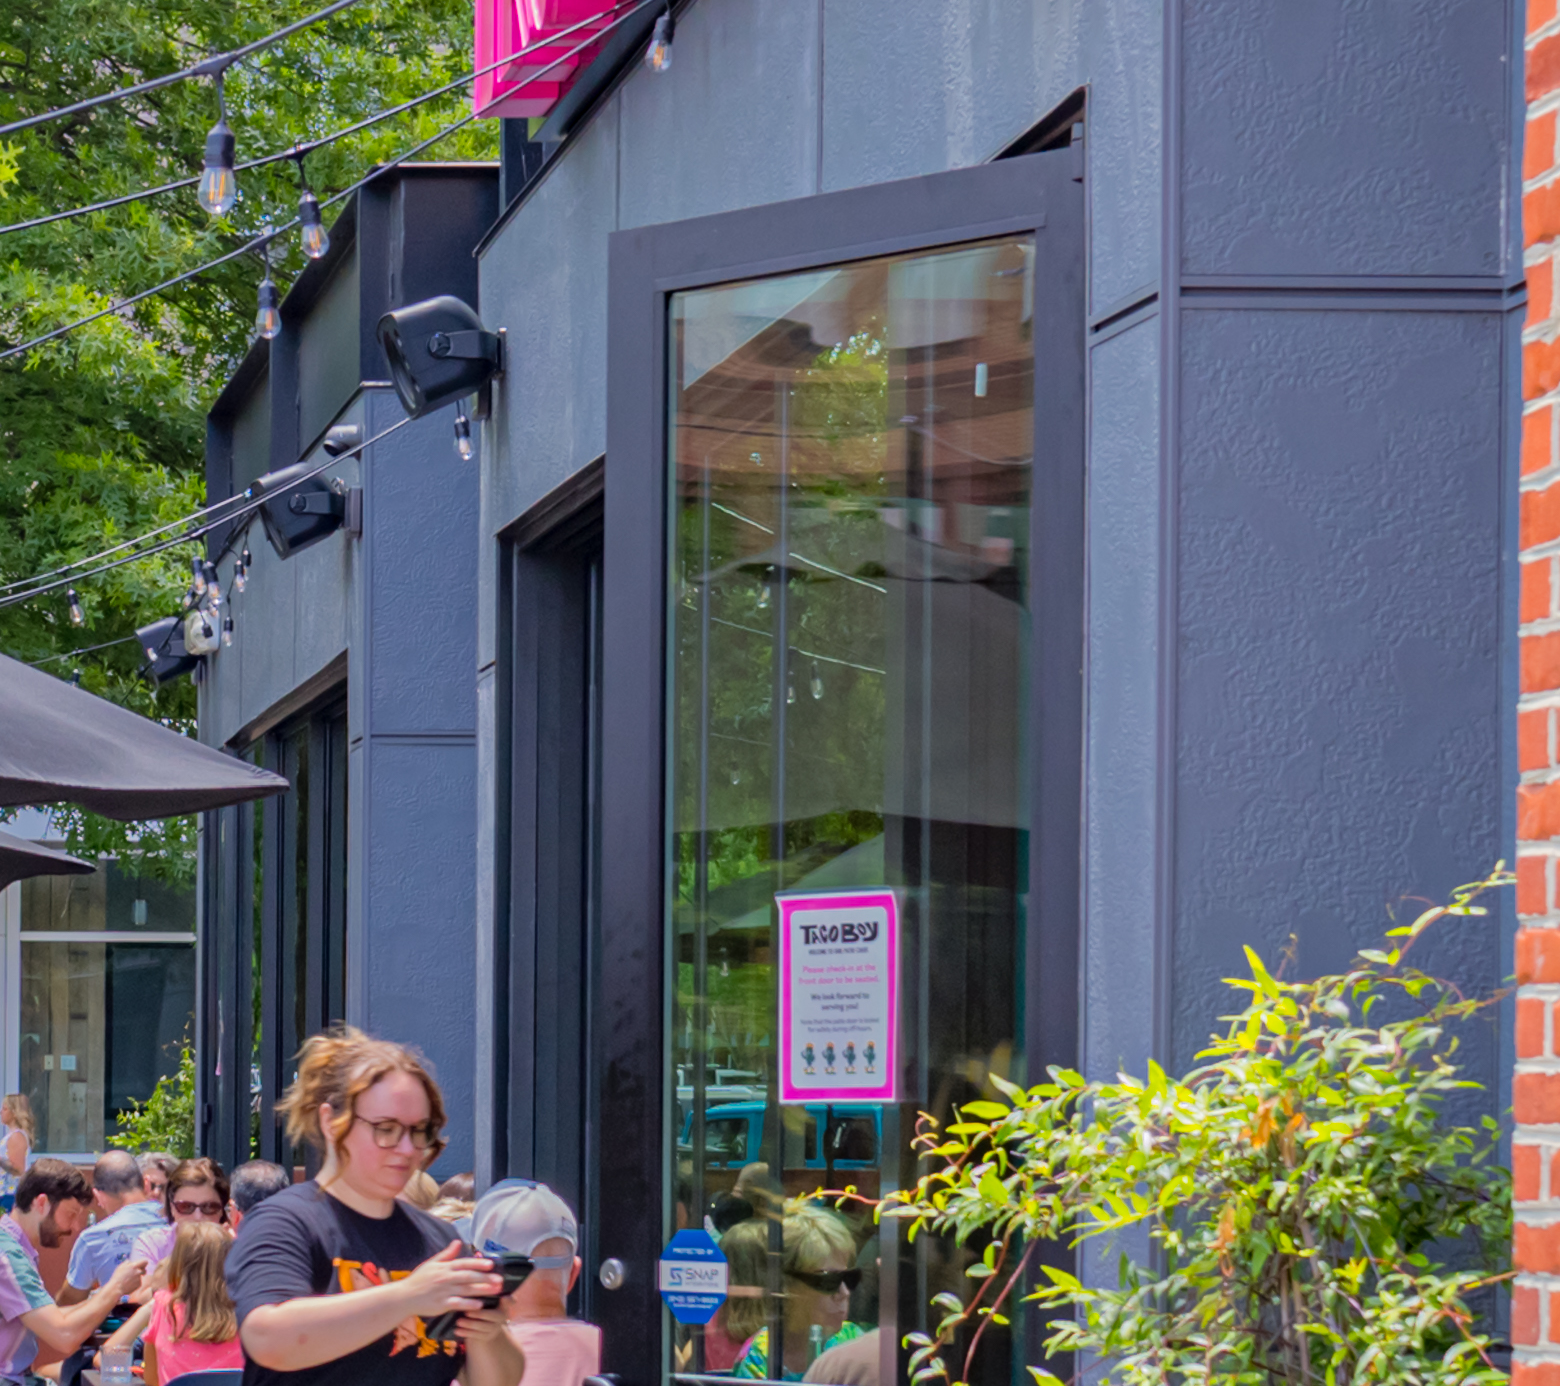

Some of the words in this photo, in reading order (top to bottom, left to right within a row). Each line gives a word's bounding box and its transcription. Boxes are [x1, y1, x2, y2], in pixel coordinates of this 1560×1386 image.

[799, 924, 839, 945] TACO
[841, 921, 879, 943] BOY
[803, 965, 824, 973] Please
[686, 1267, 720, 1281] SNAP
